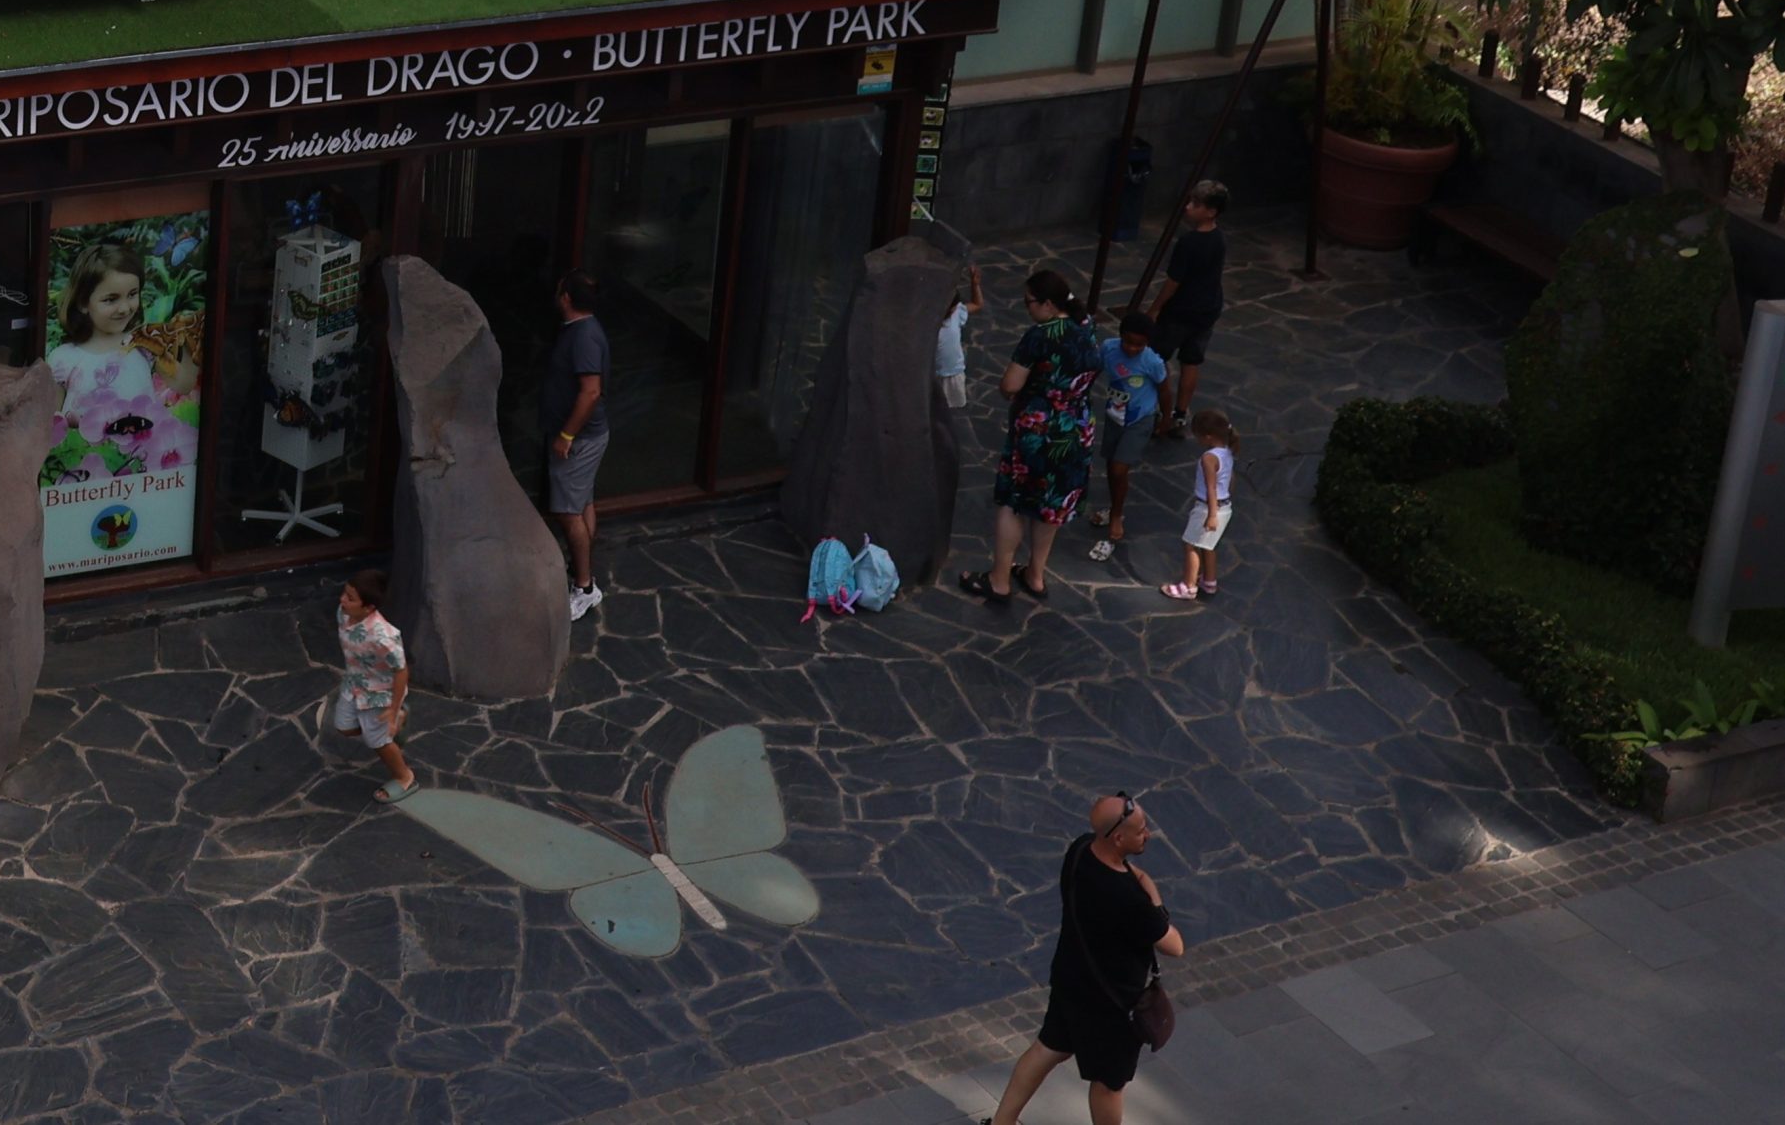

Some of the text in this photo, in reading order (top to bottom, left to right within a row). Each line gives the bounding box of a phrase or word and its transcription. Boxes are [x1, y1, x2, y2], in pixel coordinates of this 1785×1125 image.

[269, 62, 343, 109] DEL
[367, 41, 539, 97] DRAGO
[592, 11, 813, 72] BUTTERFLY
[826, 0, 928, 46] PARK
[217, 136, 263, 168] 25
[46, 471, 185, 507] Butterfly Park
[48, 545, 177, 572] www.mariposario.com
